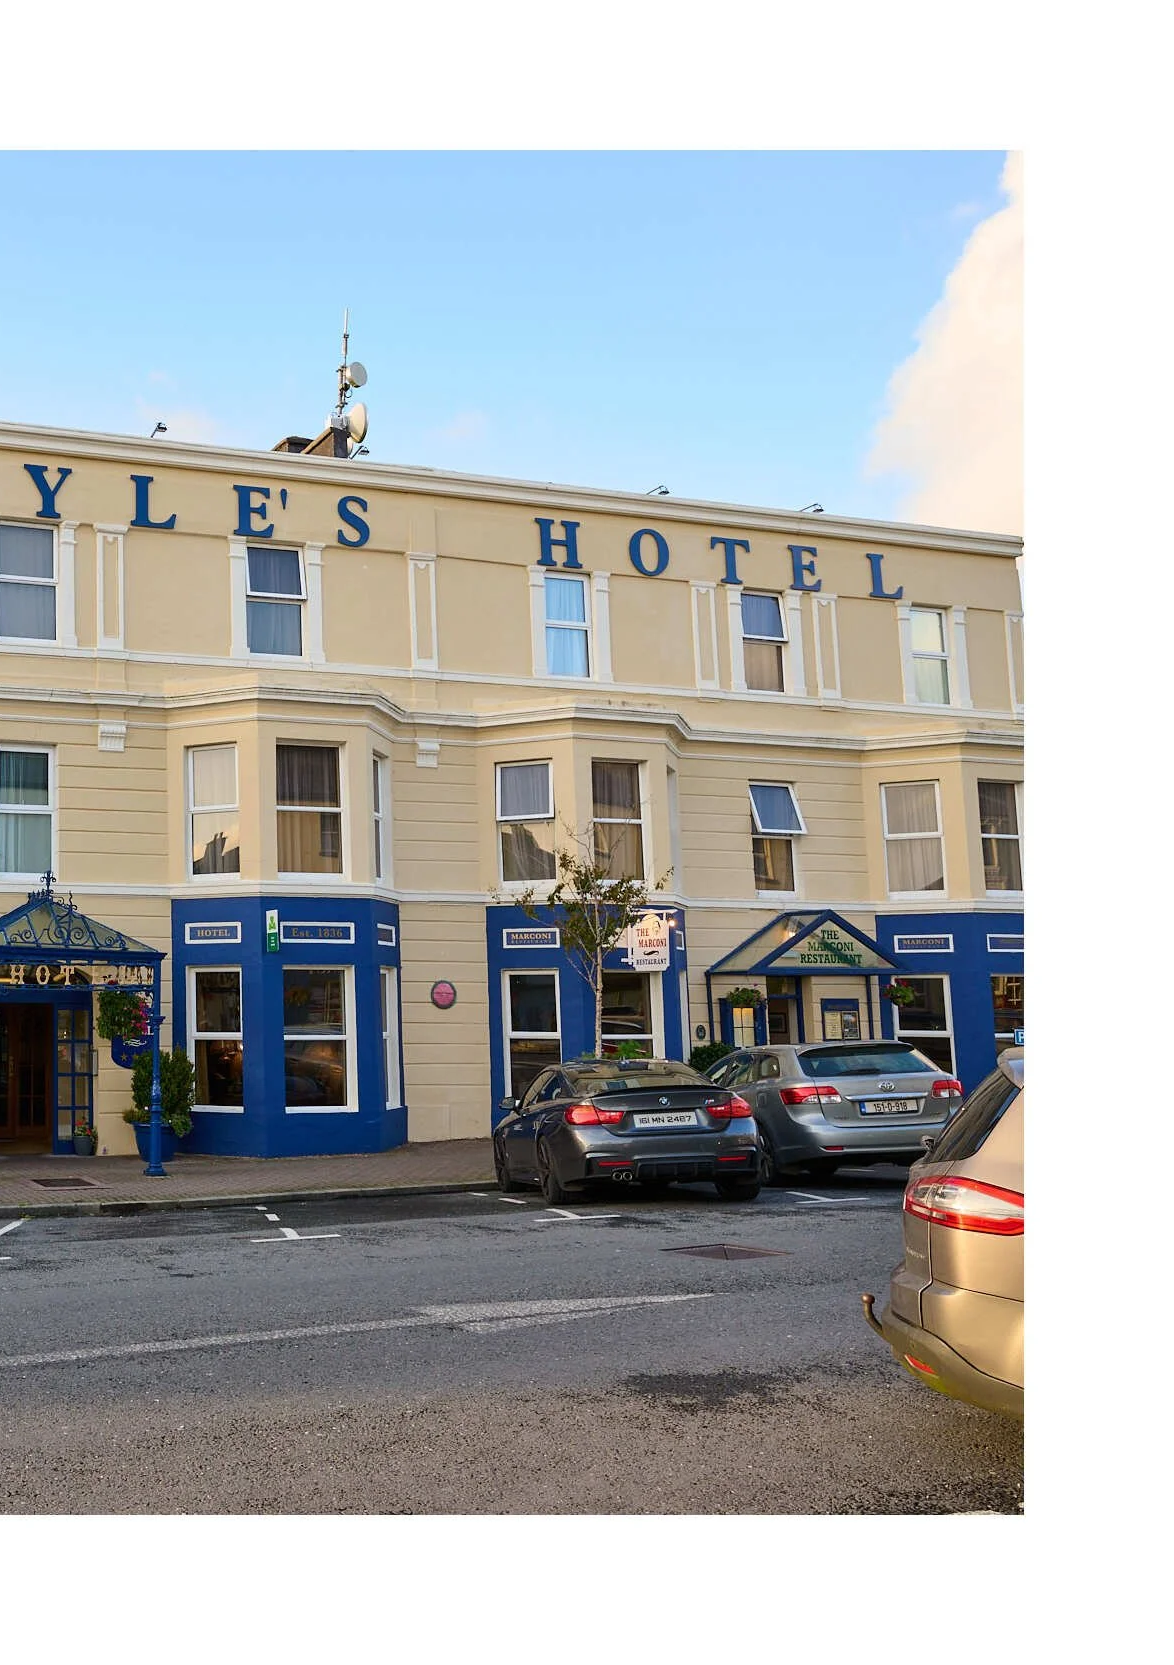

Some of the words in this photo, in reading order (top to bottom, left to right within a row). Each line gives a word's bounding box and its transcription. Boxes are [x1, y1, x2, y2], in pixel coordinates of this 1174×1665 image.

[534, 517, 903, 600] HOTEL
[196, 929, 231, 937] HOTEL
[317, 928, 343, 938] 1836
[635, 928, 650, 937] THE
[821, 930, 839, 940] THE
[638, 938, 667, 948] MARCONI
[807, 942, 854, 952] MARCONI
[800, 953, 863, 964] RESTAURANT
